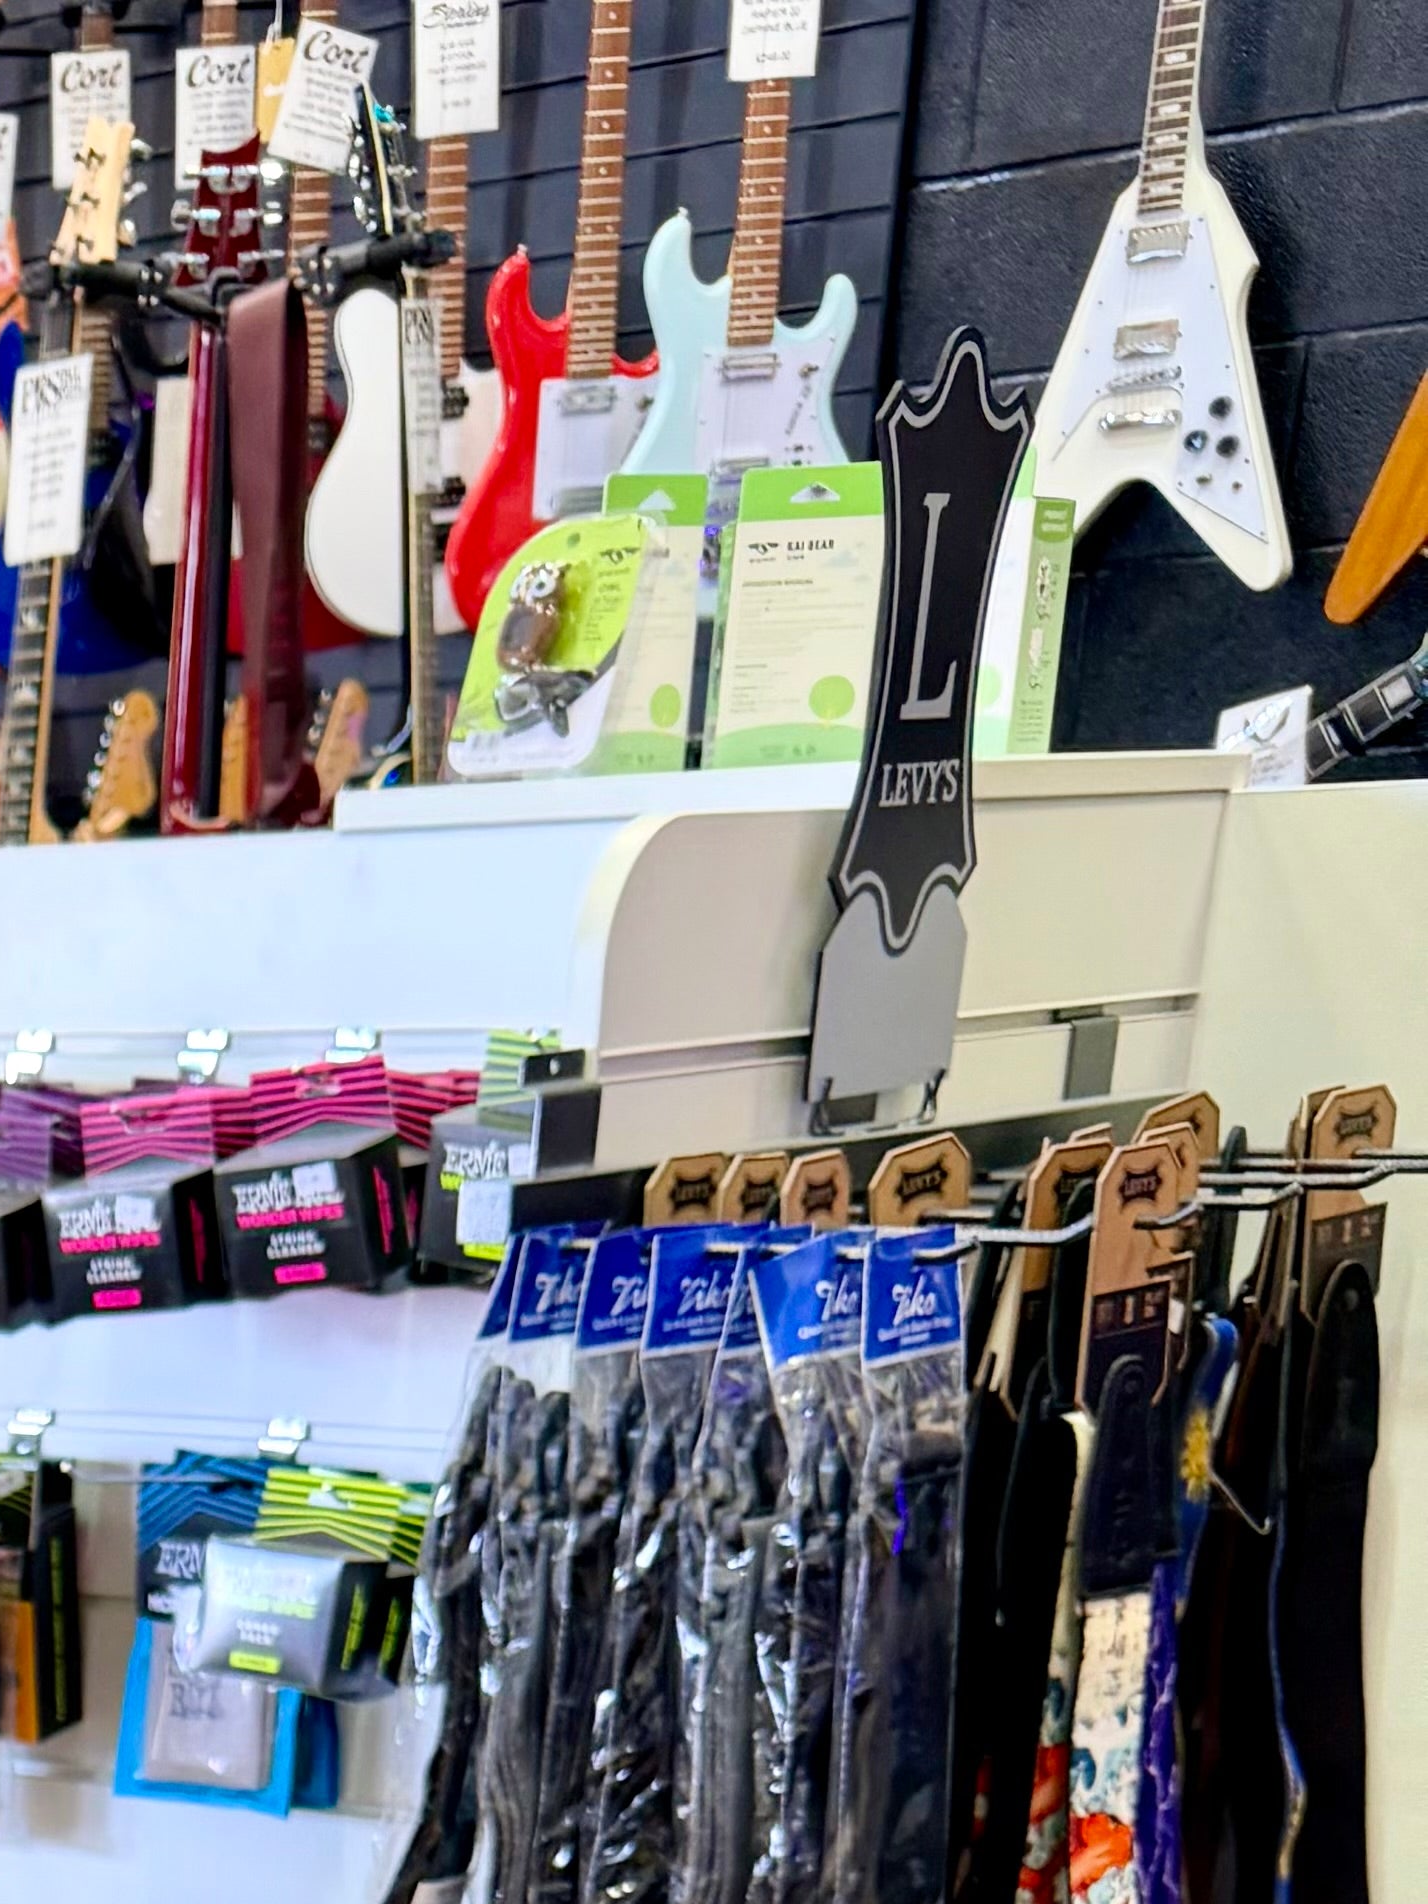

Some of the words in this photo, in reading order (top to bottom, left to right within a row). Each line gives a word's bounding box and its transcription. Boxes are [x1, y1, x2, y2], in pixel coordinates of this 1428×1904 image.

[186, 54, 249, 88] Cort
[304, 30, 369, 74] Cort
[61, 59, 123, 94] Cort
[899, 492, 958, 720] L
[232, 1172, 293, 1214] ERNIE
